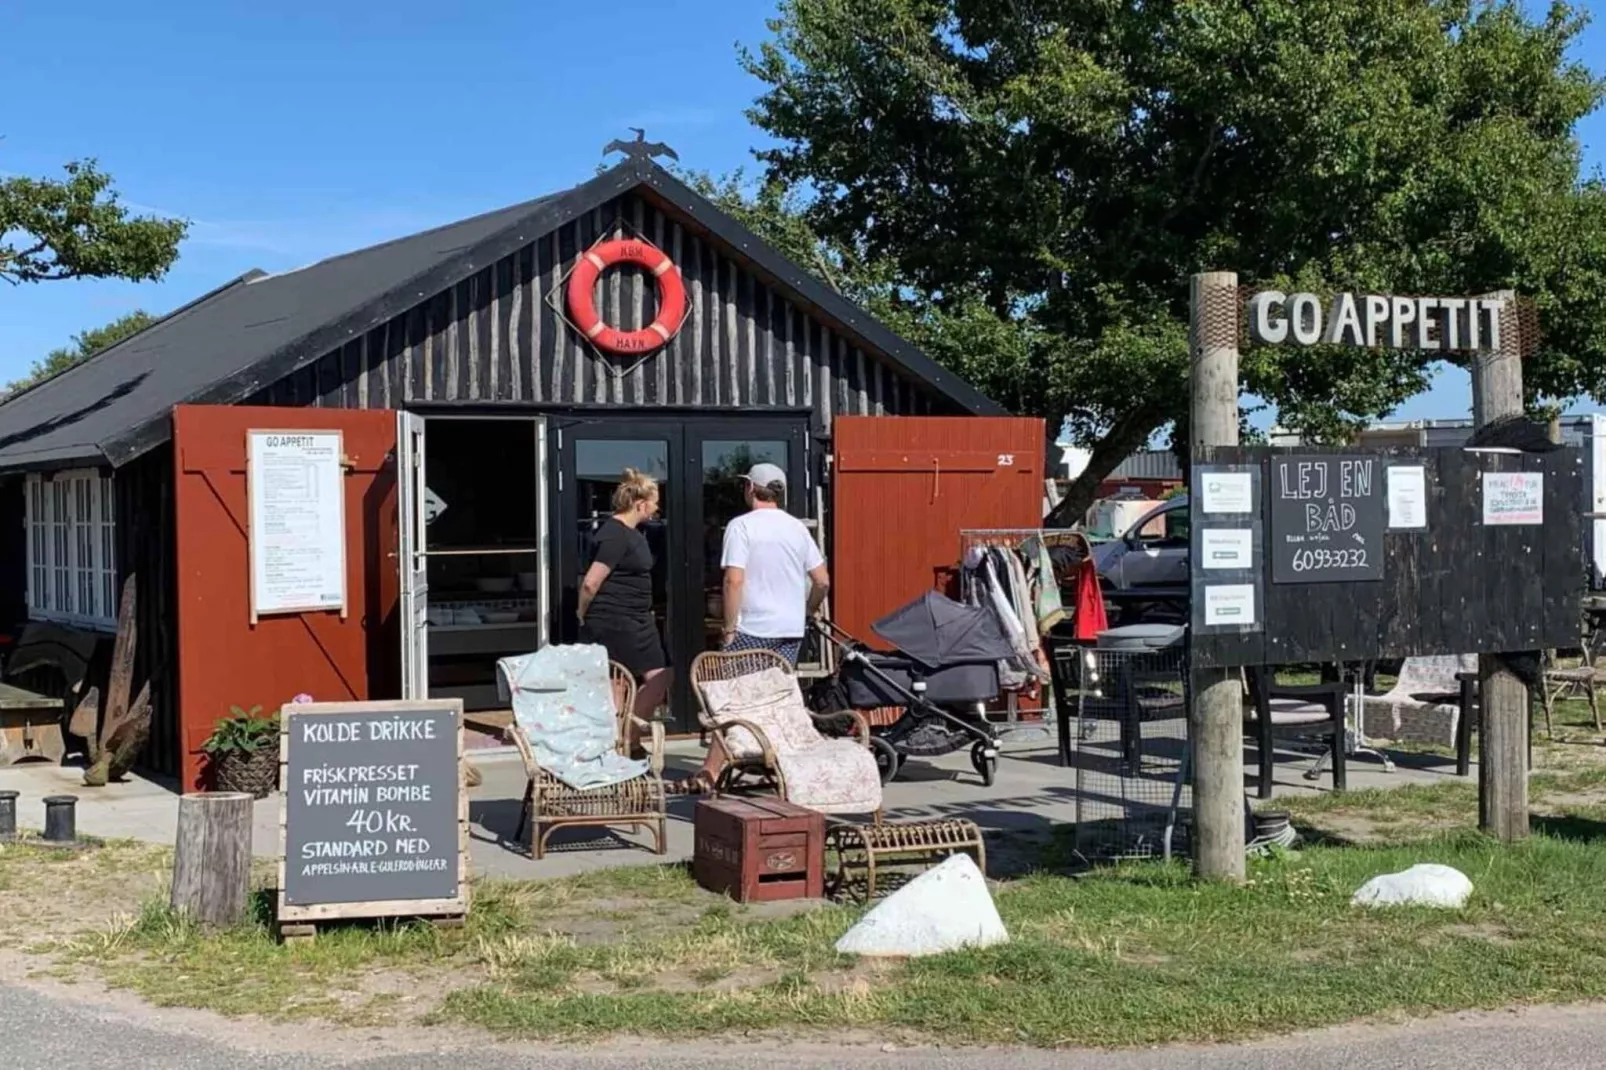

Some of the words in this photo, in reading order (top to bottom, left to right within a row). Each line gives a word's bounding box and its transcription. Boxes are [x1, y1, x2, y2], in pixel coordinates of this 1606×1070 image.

[1252, 290, 1322, 345] GO
[1325, 292, 1505, 350] APPETIT
[615, 338, 645, 349] HAVN
[266, 436, 279, 448] GO
[280, 436, 315, 447] APPETIT
[997, 453, 1016, 467] 23
[1280, 462, 1328, 499] LEJ
[1340, 460, 1373, 498] EN
[1305, 497, 1356, 532] BÅD
[1292, 547, 1369, 572] 60933232
[303, 722, 362, 743] KOLDE
[366, 715, 436, 741] DRIKKE
[303, 763, 420, 785] FRISKPRESSET
[304, 783, 369, 806] VITAMIN
[376, 785, 432, 802] BOMBE
[346, 809, 383, 834] 40
[386, 809, 418, 833] KR.
[301, 840, 389, 860] STANDARD
[395, 838, 431, 855] MED
